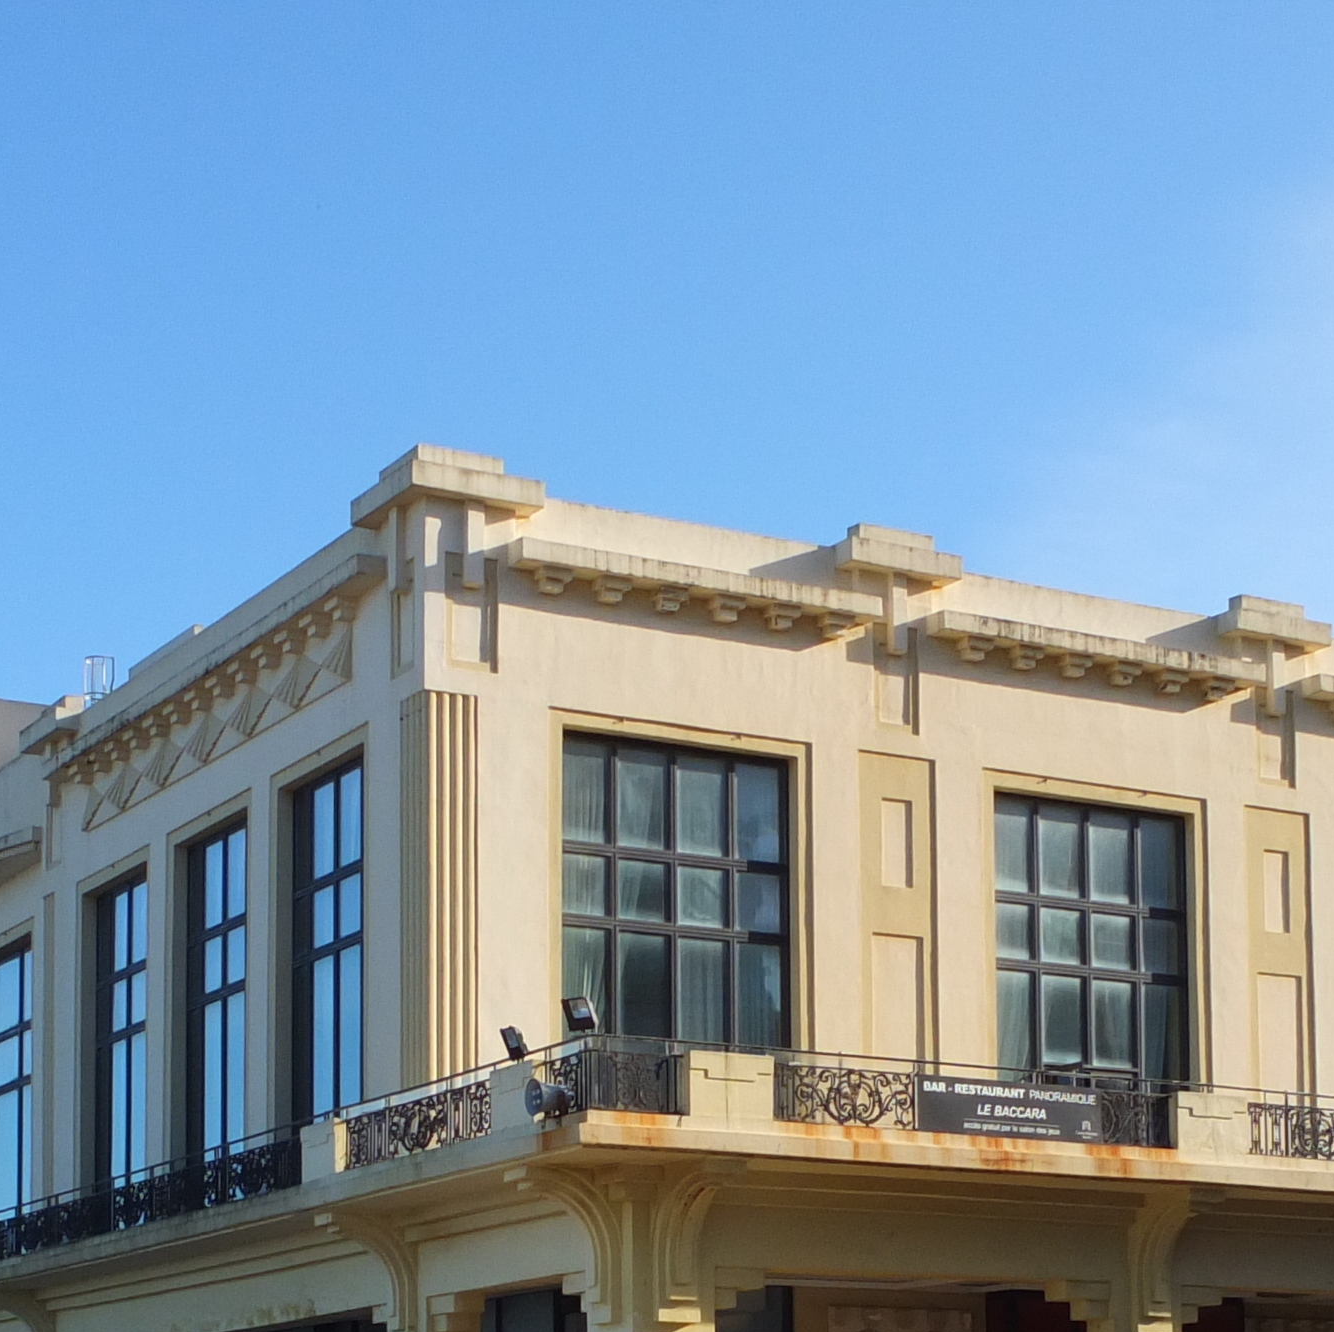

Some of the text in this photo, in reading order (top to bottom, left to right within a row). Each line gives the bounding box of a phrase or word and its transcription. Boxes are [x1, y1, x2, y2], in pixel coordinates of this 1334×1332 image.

[923, 1081, 946, 1093] BAR
[954, 1083, 1026, 1099] RESTAURANT
[1029, 1089, 1097, 1106] PANORAMIQUE
[977, 1104, 1047, 1120] LE BACCARA
